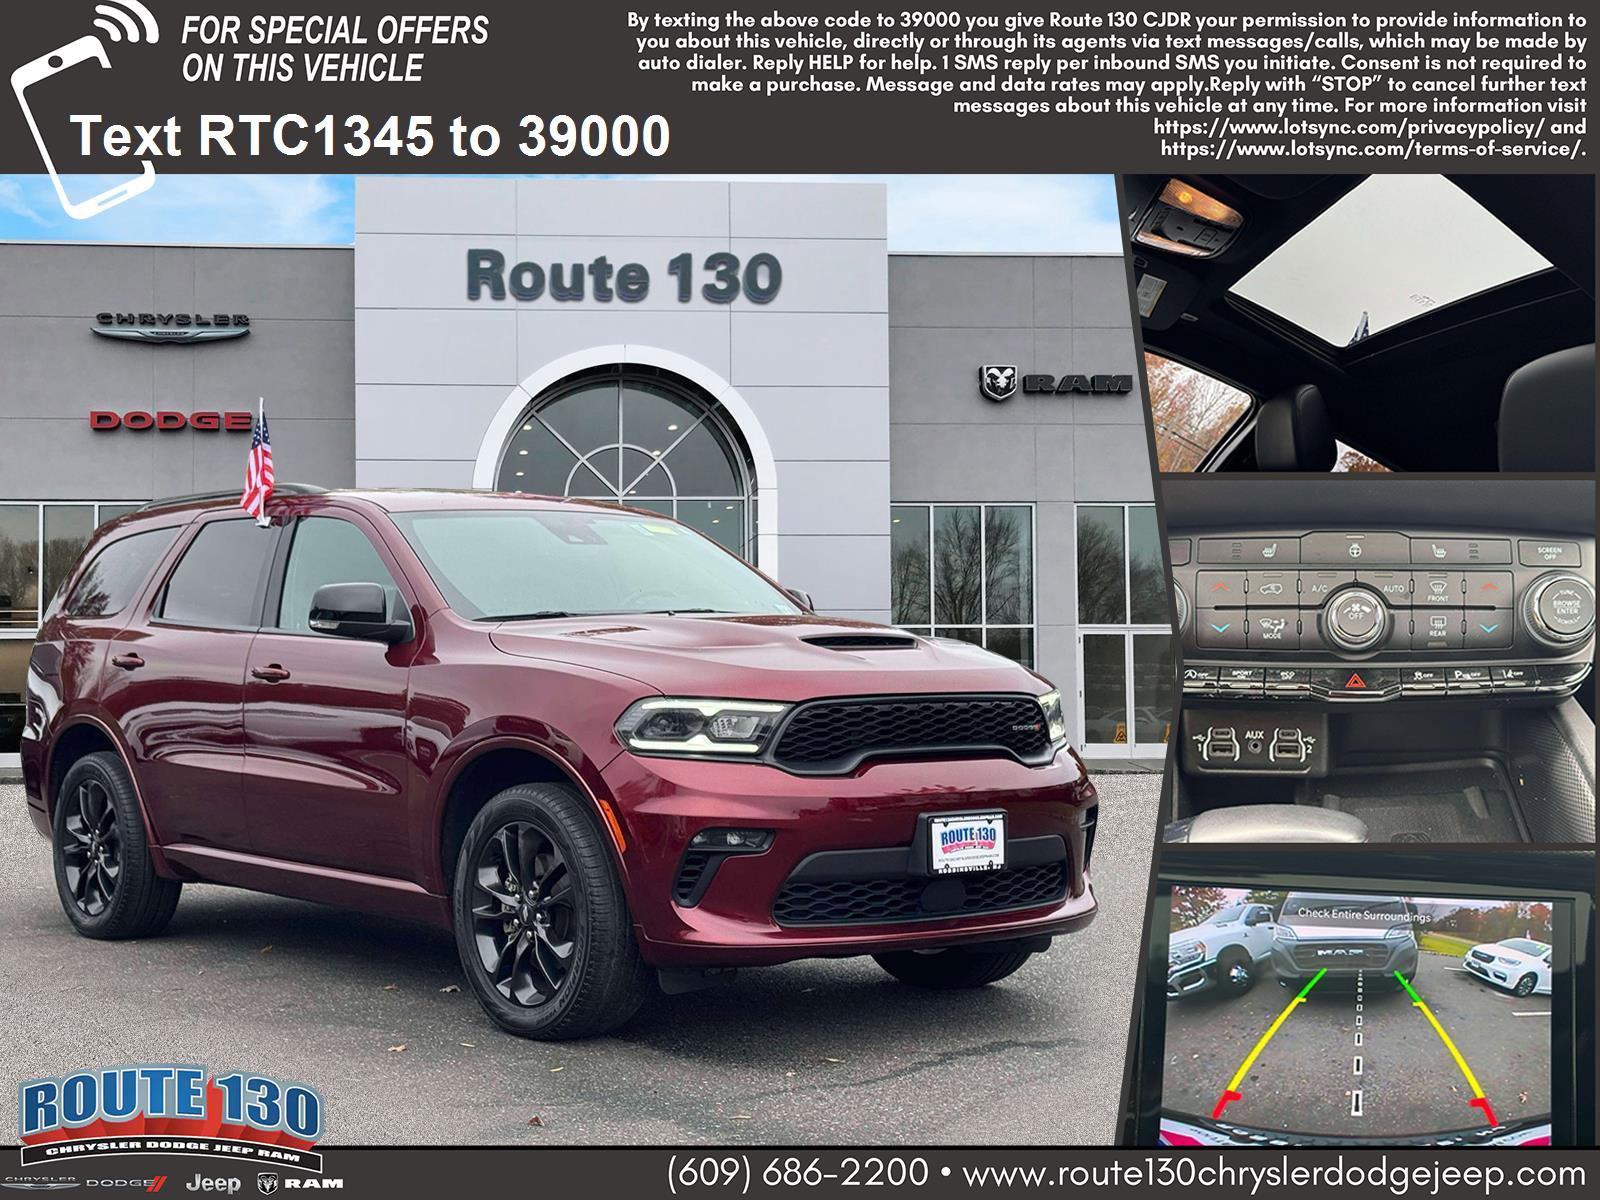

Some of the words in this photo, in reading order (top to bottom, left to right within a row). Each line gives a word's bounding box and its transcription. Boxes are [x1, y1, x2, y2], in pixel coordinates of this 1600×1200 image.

[467, 248, 649, 302] Route
[667, 252, 782, 304] 130
[96, 313, 250, 326] CHRYSLER
[1022, 374, 1133, 396] RAM
[90, 411, 253, 432] DODGE
[1537, 546, 1562, 554] SCREEN
[1312, 585, 1328, 593] A/C
[1383, 585, 1405, 593] AUTO
[1349, 612, 1364, 620] OFF
[1245, 731, 1264, 739] AUX
[1306, 746, 1313, 754] 2
[940, 828, 975, 846] ROUTE
[977, 827, 996, 841] 130
[1298, 907, 1330, 918] Check
[1332, 909, 1362, 920] Entire
[1363, 910, 1432, 925] Surroundings
